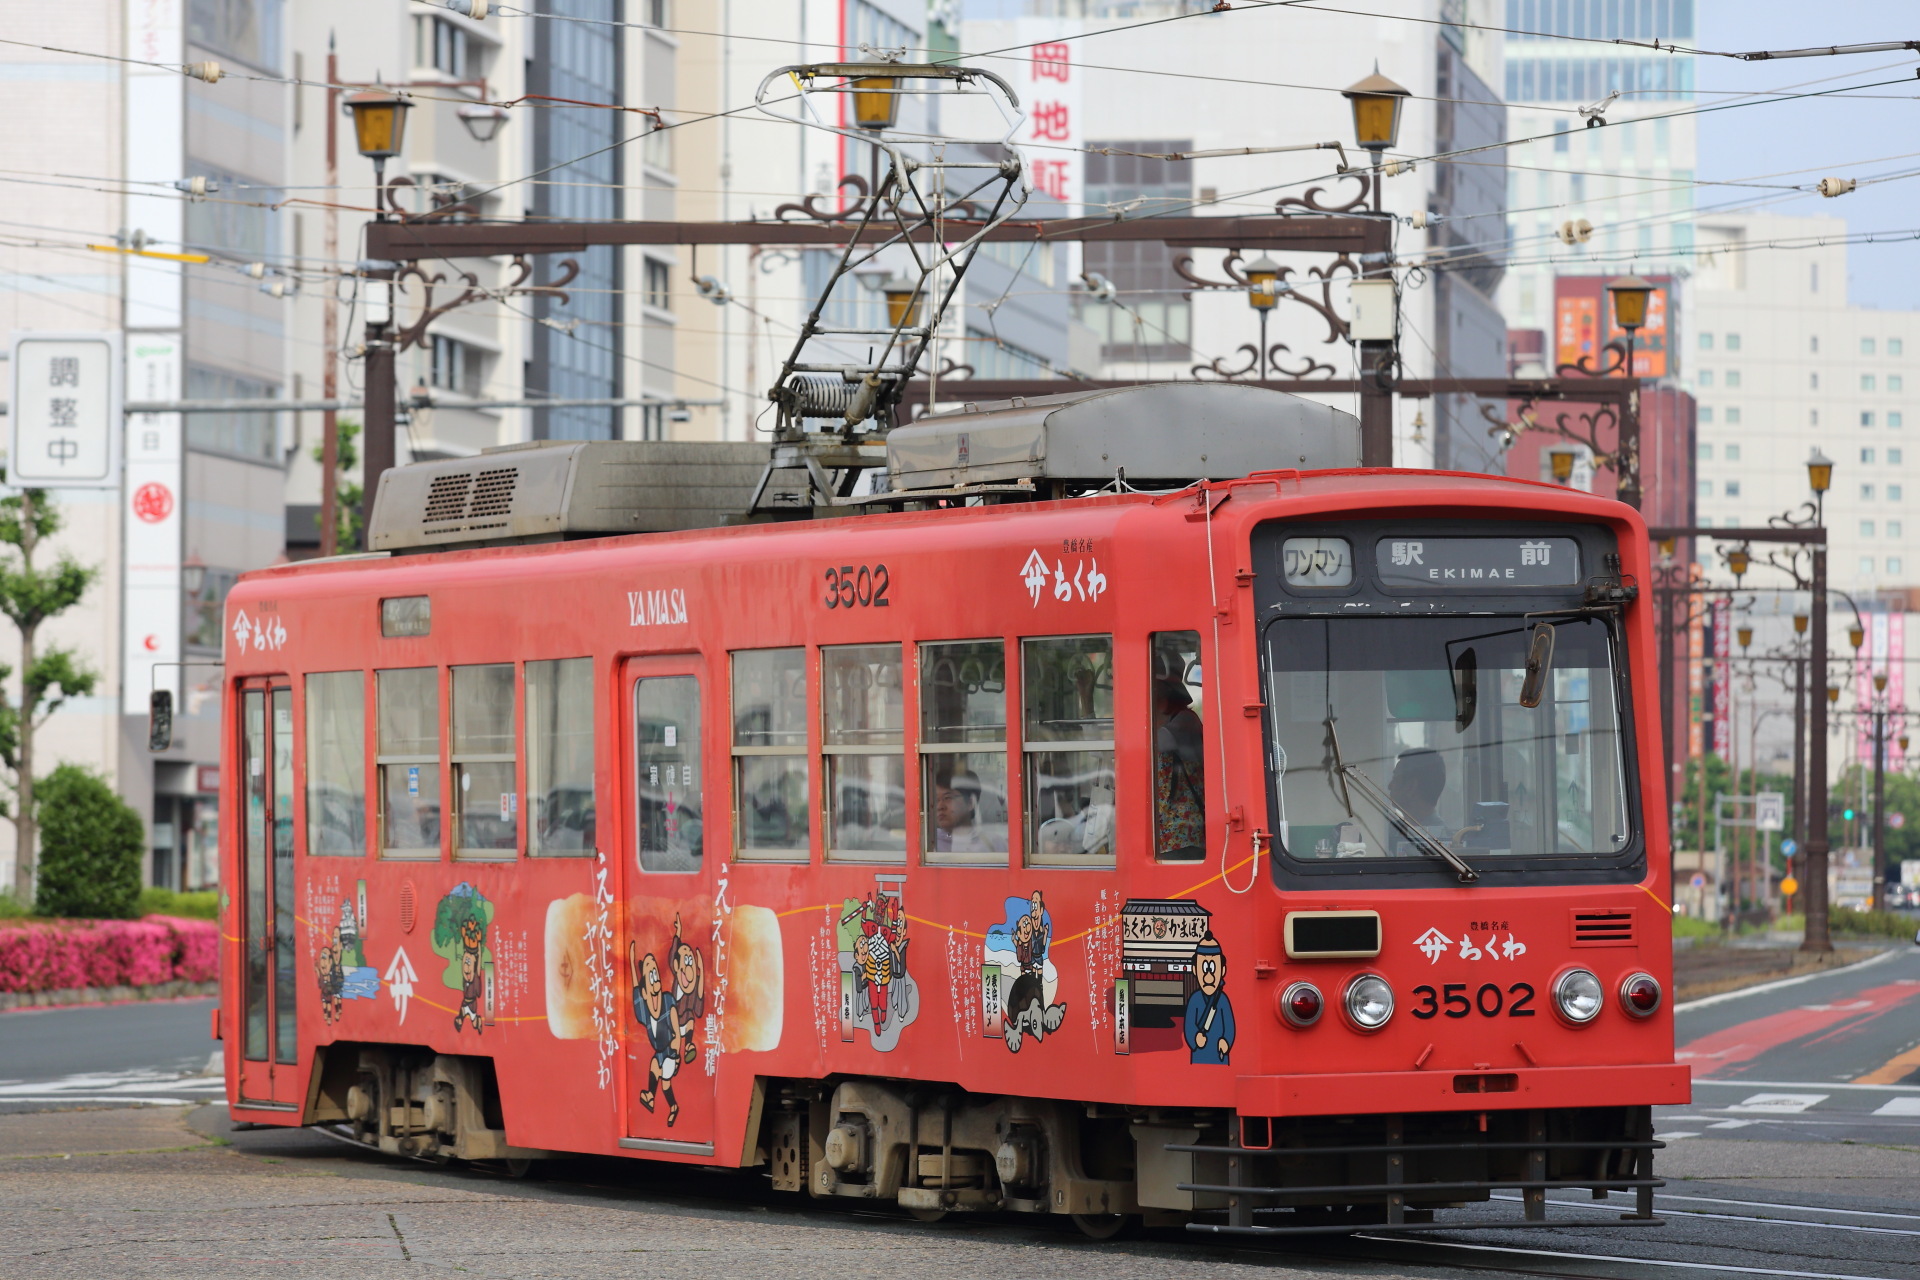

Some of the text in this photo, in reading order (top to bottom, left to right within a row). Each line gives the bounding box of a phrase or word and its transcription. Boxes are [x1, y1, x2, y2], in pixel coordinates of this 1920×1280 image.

[1031, 42, 1069, 201] 岡地証
[48, 356, 78, 466] 調整中
[1054, 557, 1107, 603] ちくわ
[1285, 549, 1344, 577] ワンマン
[1430, 568, 1515, 579] EKIMAE
[824, 564, 889, 608] 3502
[627, 588, 688, 626] YAMASA
[254, 616, 287, 651] ちくわ
[1123, 916, 1152, 939] ちくわ
[1470, 921, 1510, 931] 豊橋名産
[597, 852, 619, 1056] ええじゃないか
[1459, 932, 1526, 961] ちくわ
[583, 920, 611, 1090] ヤマサちくわ
[1411, 982, 1536, 1020] 3502
